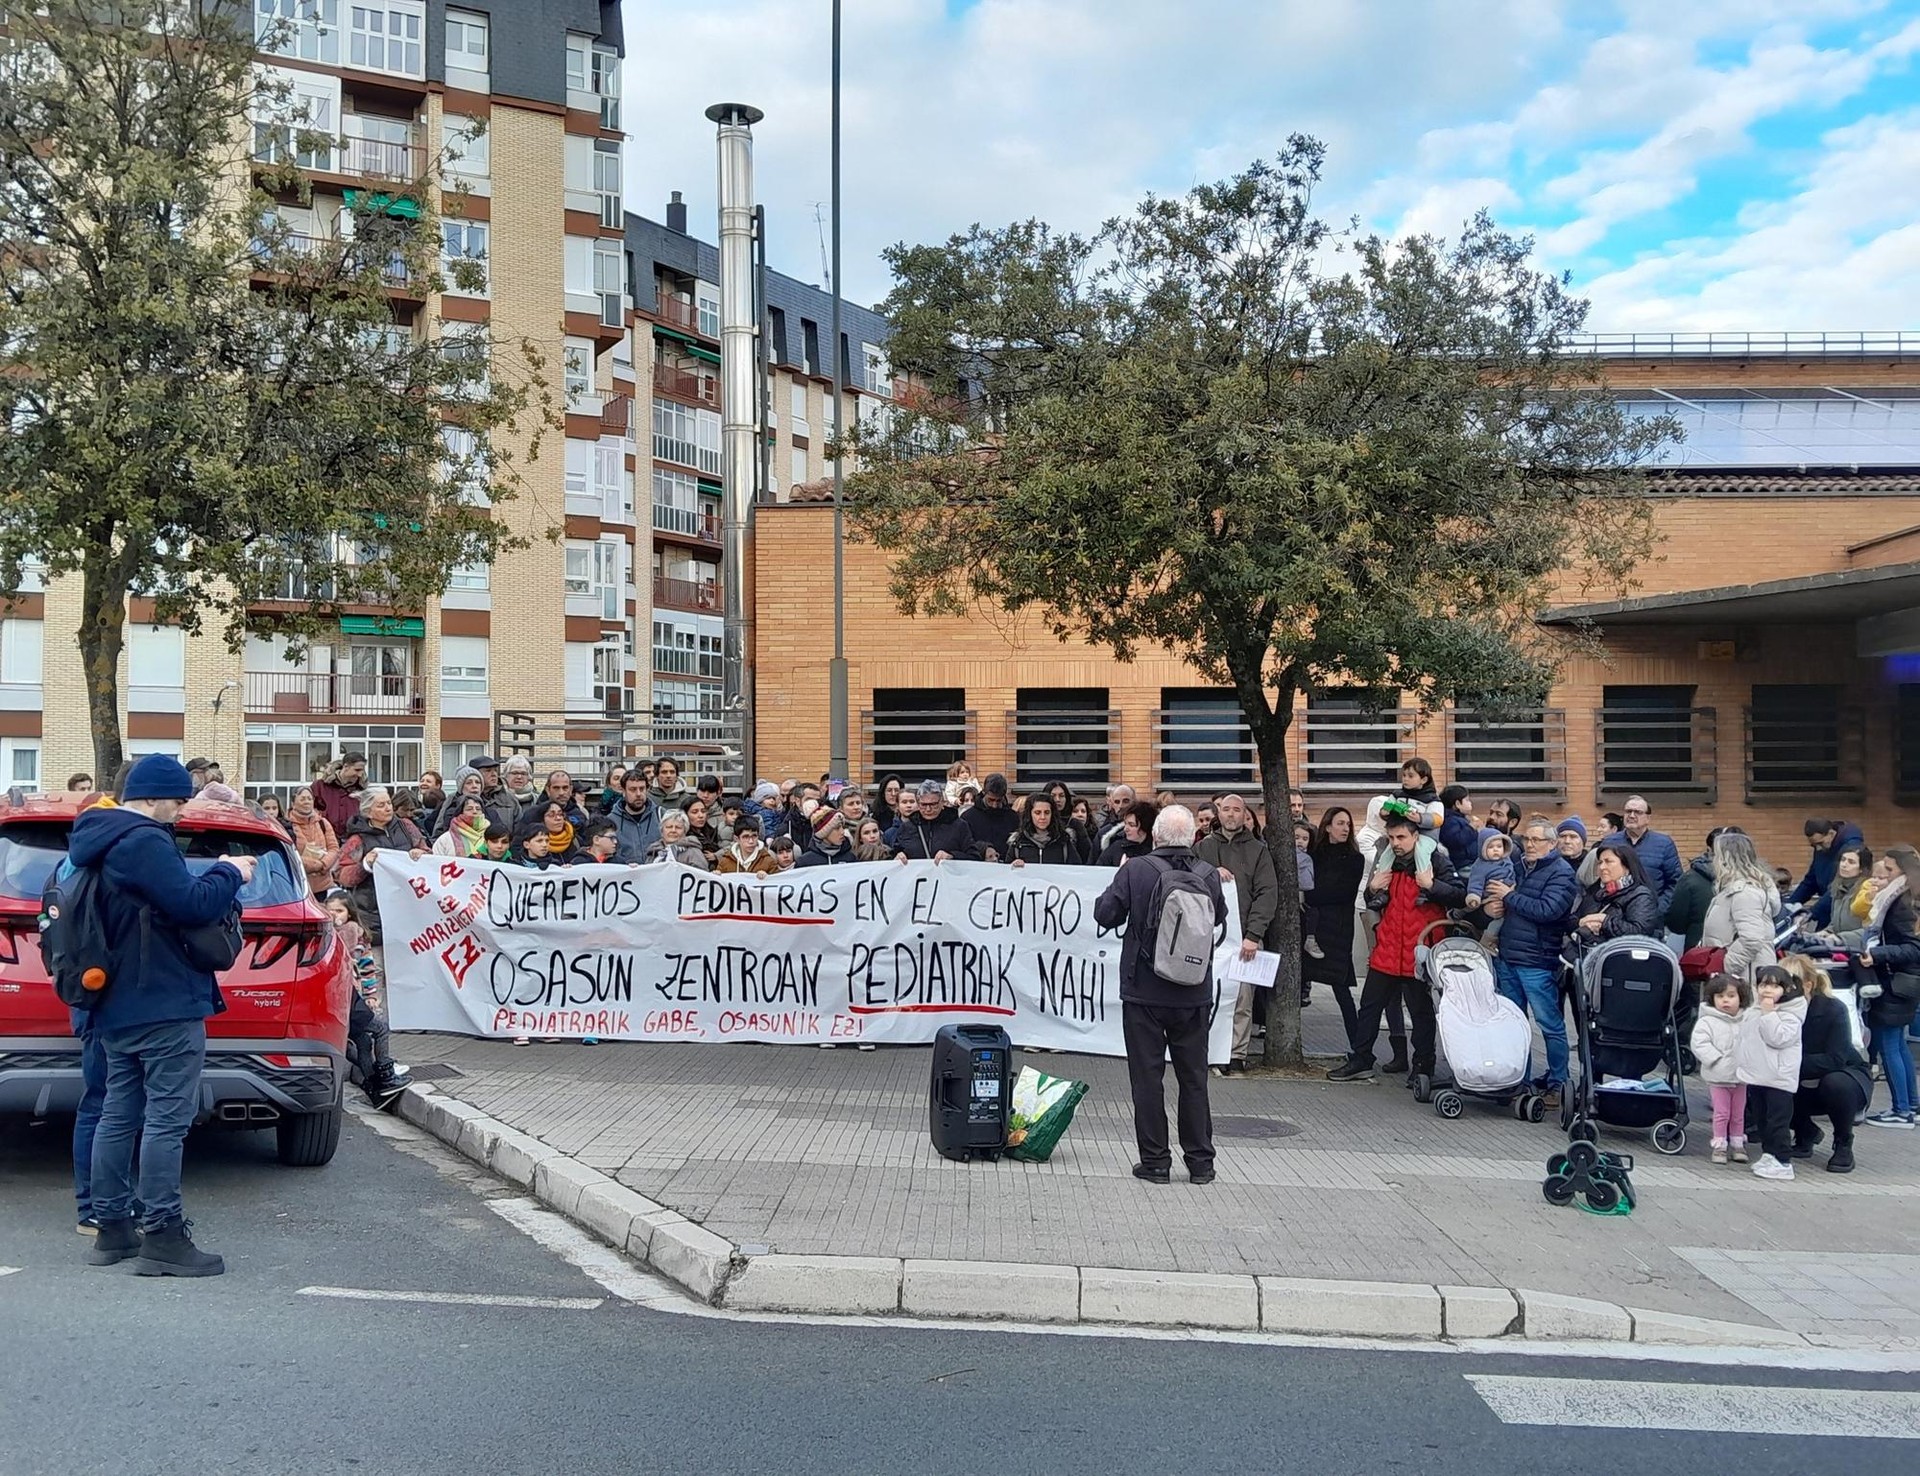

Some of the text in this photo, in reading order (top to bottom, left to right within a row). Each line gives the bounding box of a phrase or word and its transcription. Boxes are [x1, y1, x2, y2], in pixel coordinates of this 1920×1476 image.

[488, 868, 1081, 942] QUEREMOS PEDIATRAS EN EL CENTRO
[254, 999, 281, 1008] hybrid
[490, 932, 1106, 1023] OSASUN ZENTROAN PEDIATRAK NAHI
[493, 1008, 630, 1034] PEDIATRARIK
[643, 1010, 707, 1038] GABE,
[718, 1007, 820, 1036] OSASUNIK
